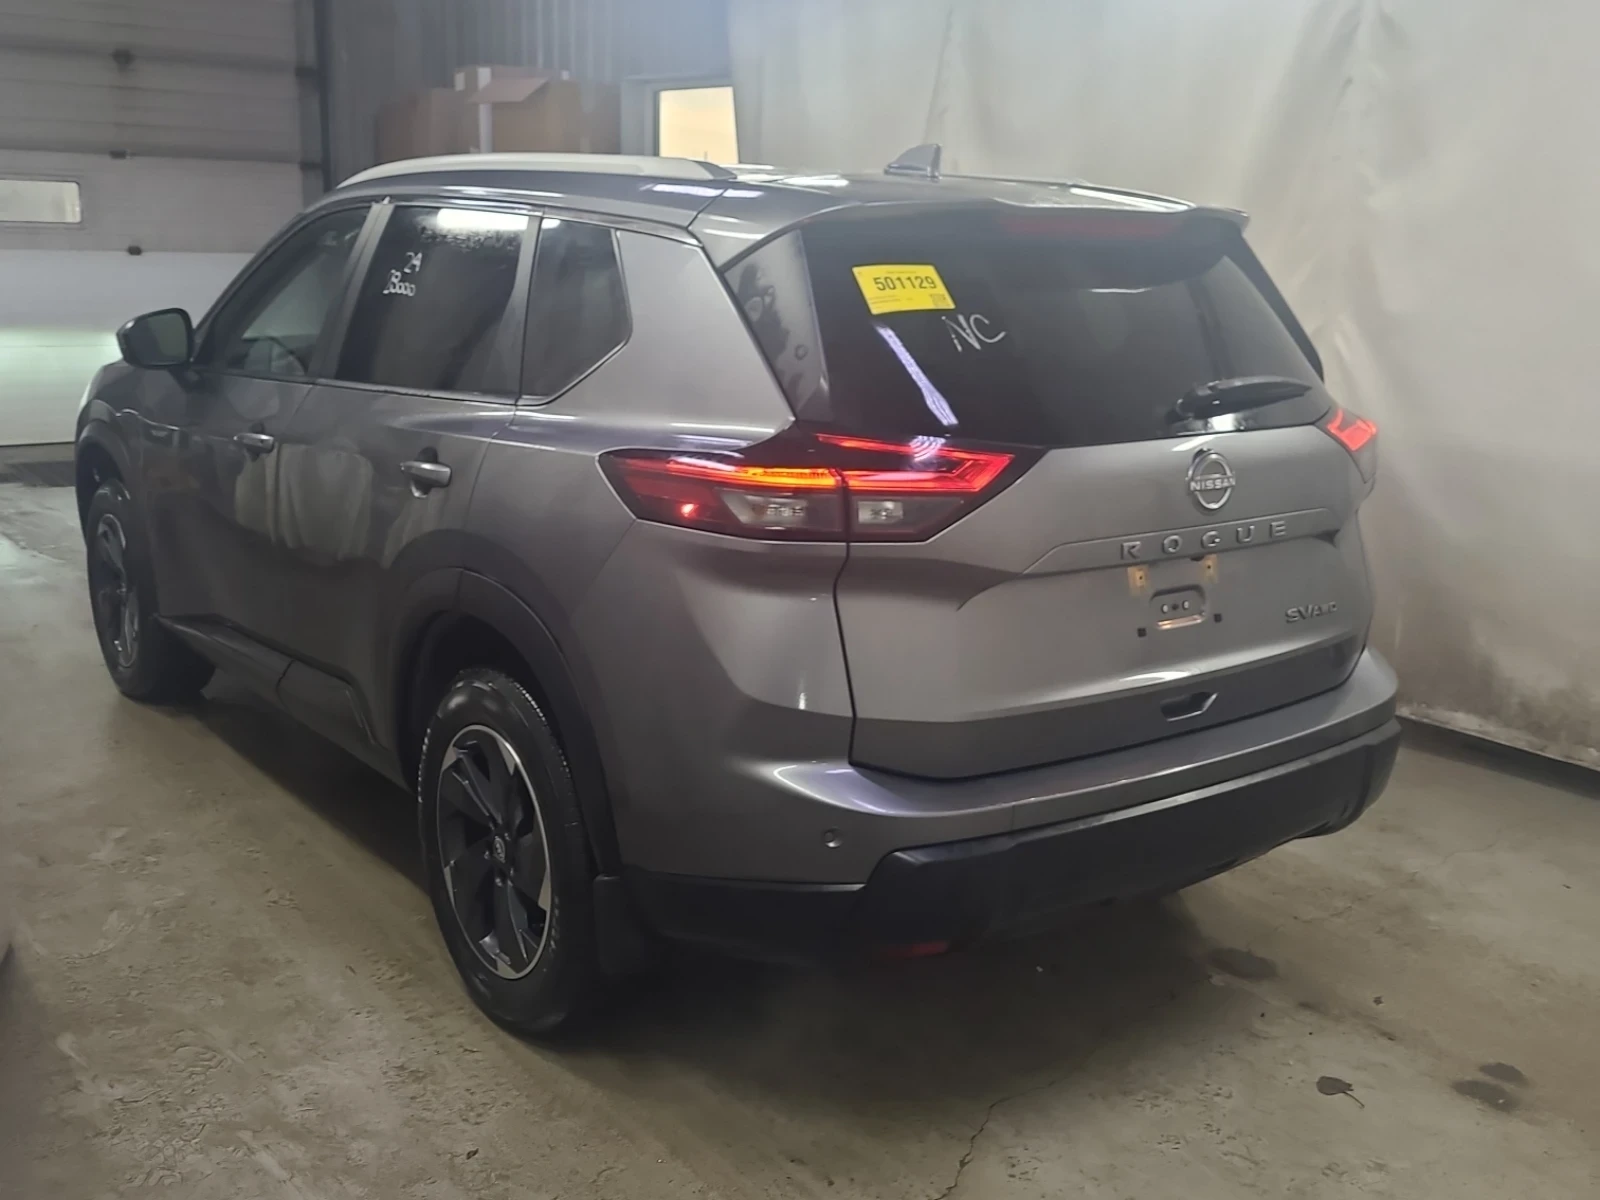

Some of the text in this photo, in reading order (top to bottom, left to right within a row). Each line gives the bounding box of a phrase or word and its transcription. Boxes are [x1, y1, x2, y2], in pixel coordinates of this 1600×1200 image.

[873, 275, 937, 291] 501129
[941, 313, 1007, 352] NC
[1190, 478, 1236, 491] NISSAN
[1120, 520, 1287, 560] ROGUE
